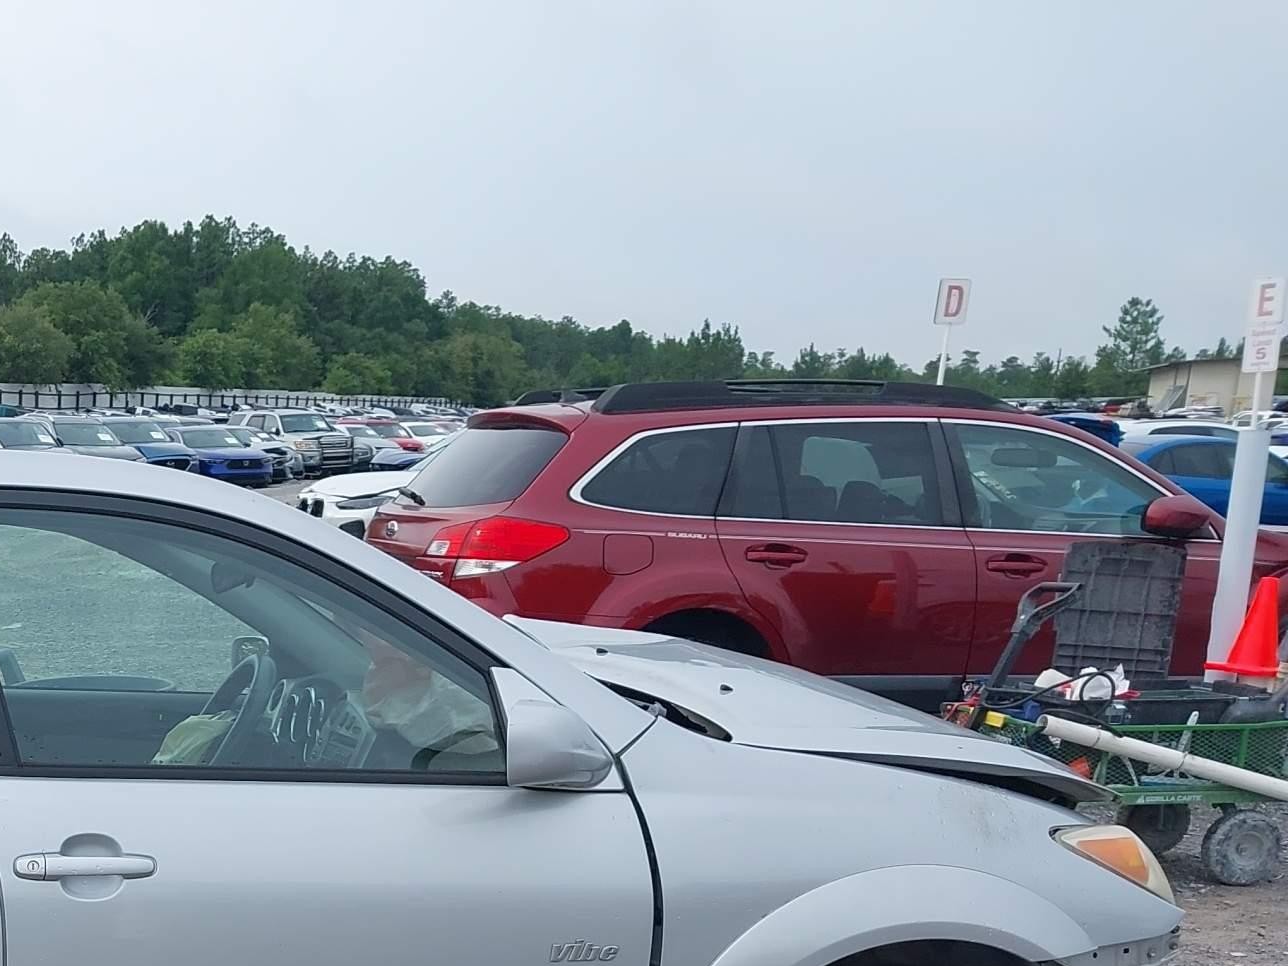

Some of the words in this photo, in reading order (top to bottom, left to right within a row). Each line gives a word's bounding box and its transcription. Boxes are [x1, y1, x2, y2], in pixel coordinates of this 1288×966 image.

[944, 285, 964, 317] D
[1256, 282, 1277, 317] E
[1255, 347, 1267, 360] 5
